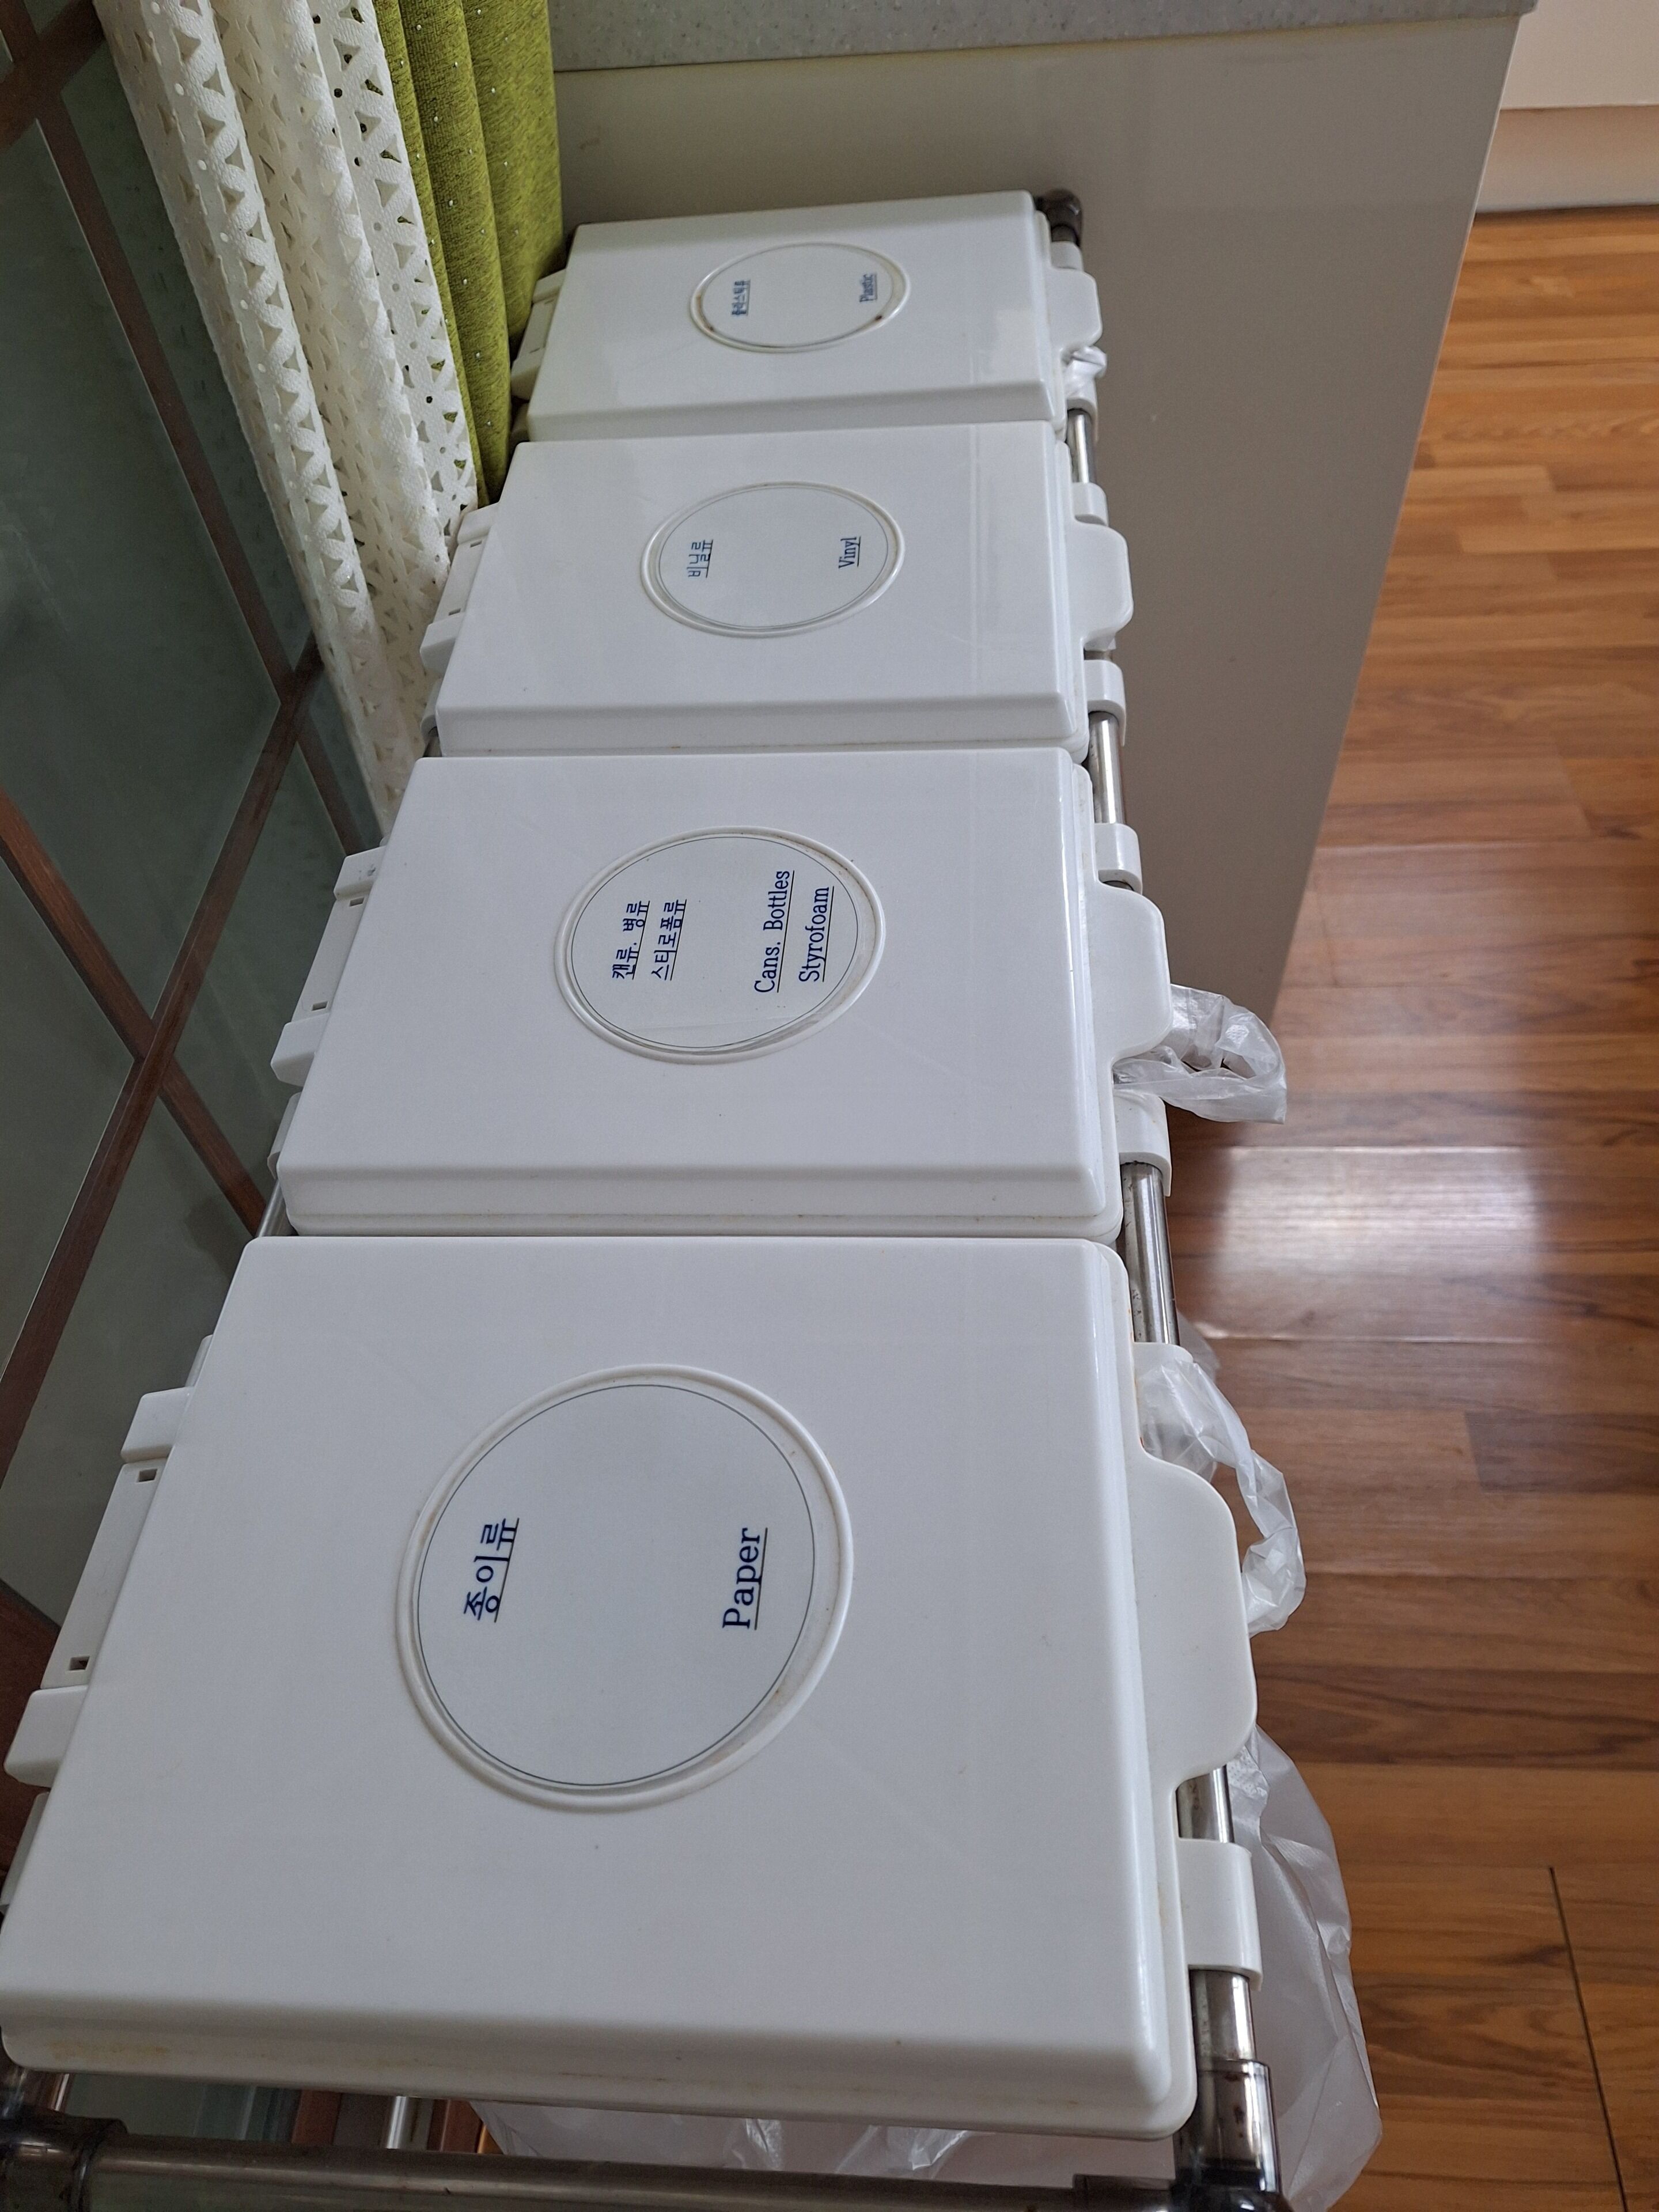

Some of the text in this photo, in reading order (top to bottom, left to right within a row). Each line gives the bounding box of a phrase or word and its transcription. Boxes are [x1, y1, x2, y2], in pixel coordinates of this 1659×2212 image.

[859, 274, 876, 302] Plastic
[687, 540, 713, 577] 비닐류
[838, 537, 859, 568] Vinyl
[623, 900, 649, 931] 병류
[652, 899, 685, 980] 스티로폼류
[754, 870, 790, 993] Cans. Bottles
[799, 887, 830, 982] Styrofoam
[464, 1518, 518, 1620] 종이류
[722, 1528, 762, 1628] Paper
